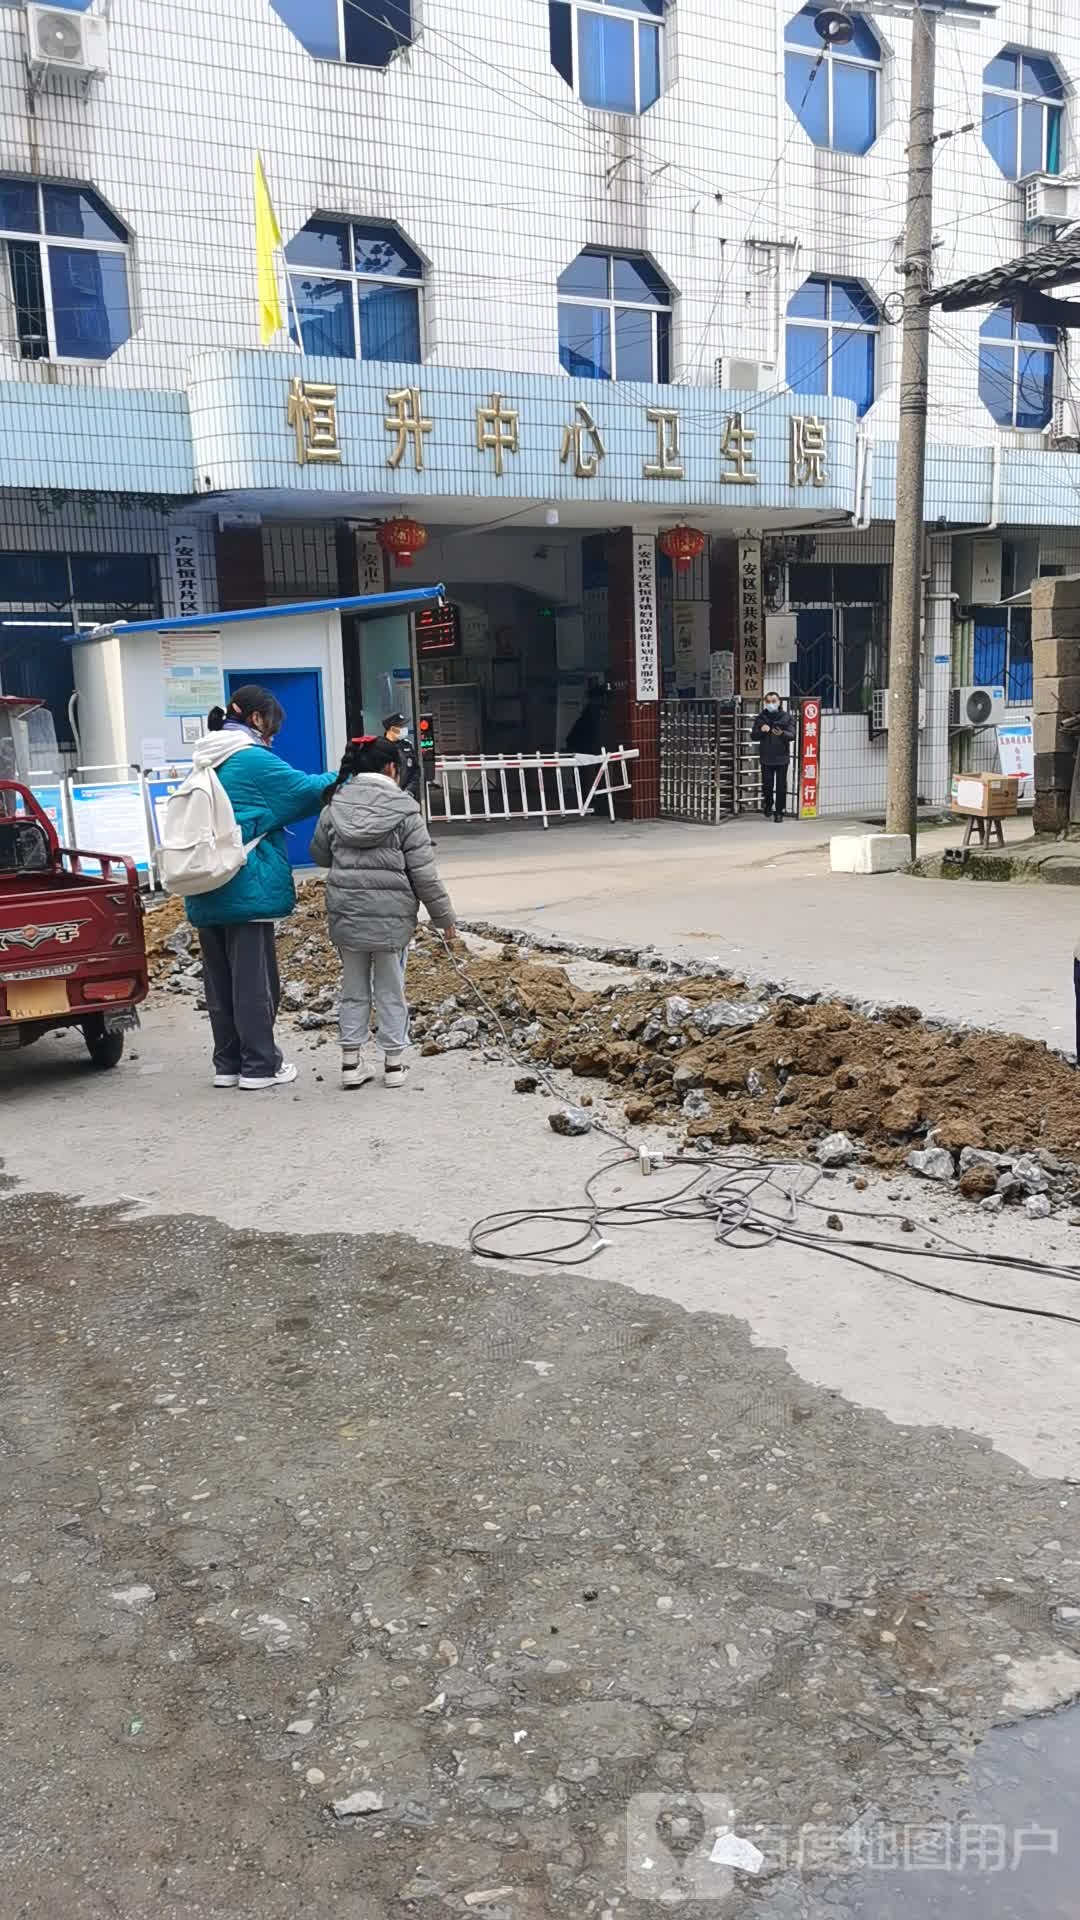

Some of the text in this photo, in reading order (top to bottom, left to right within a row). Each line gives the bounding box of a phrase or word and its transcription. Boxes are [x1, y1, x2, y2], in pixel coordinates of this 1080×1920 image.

[288, 377, 829, 488] 恒升中心卫生院
[743, 547, 760, 691] 广安区医共体成员单位
[803, 721, 818, 800] 禁止通行
